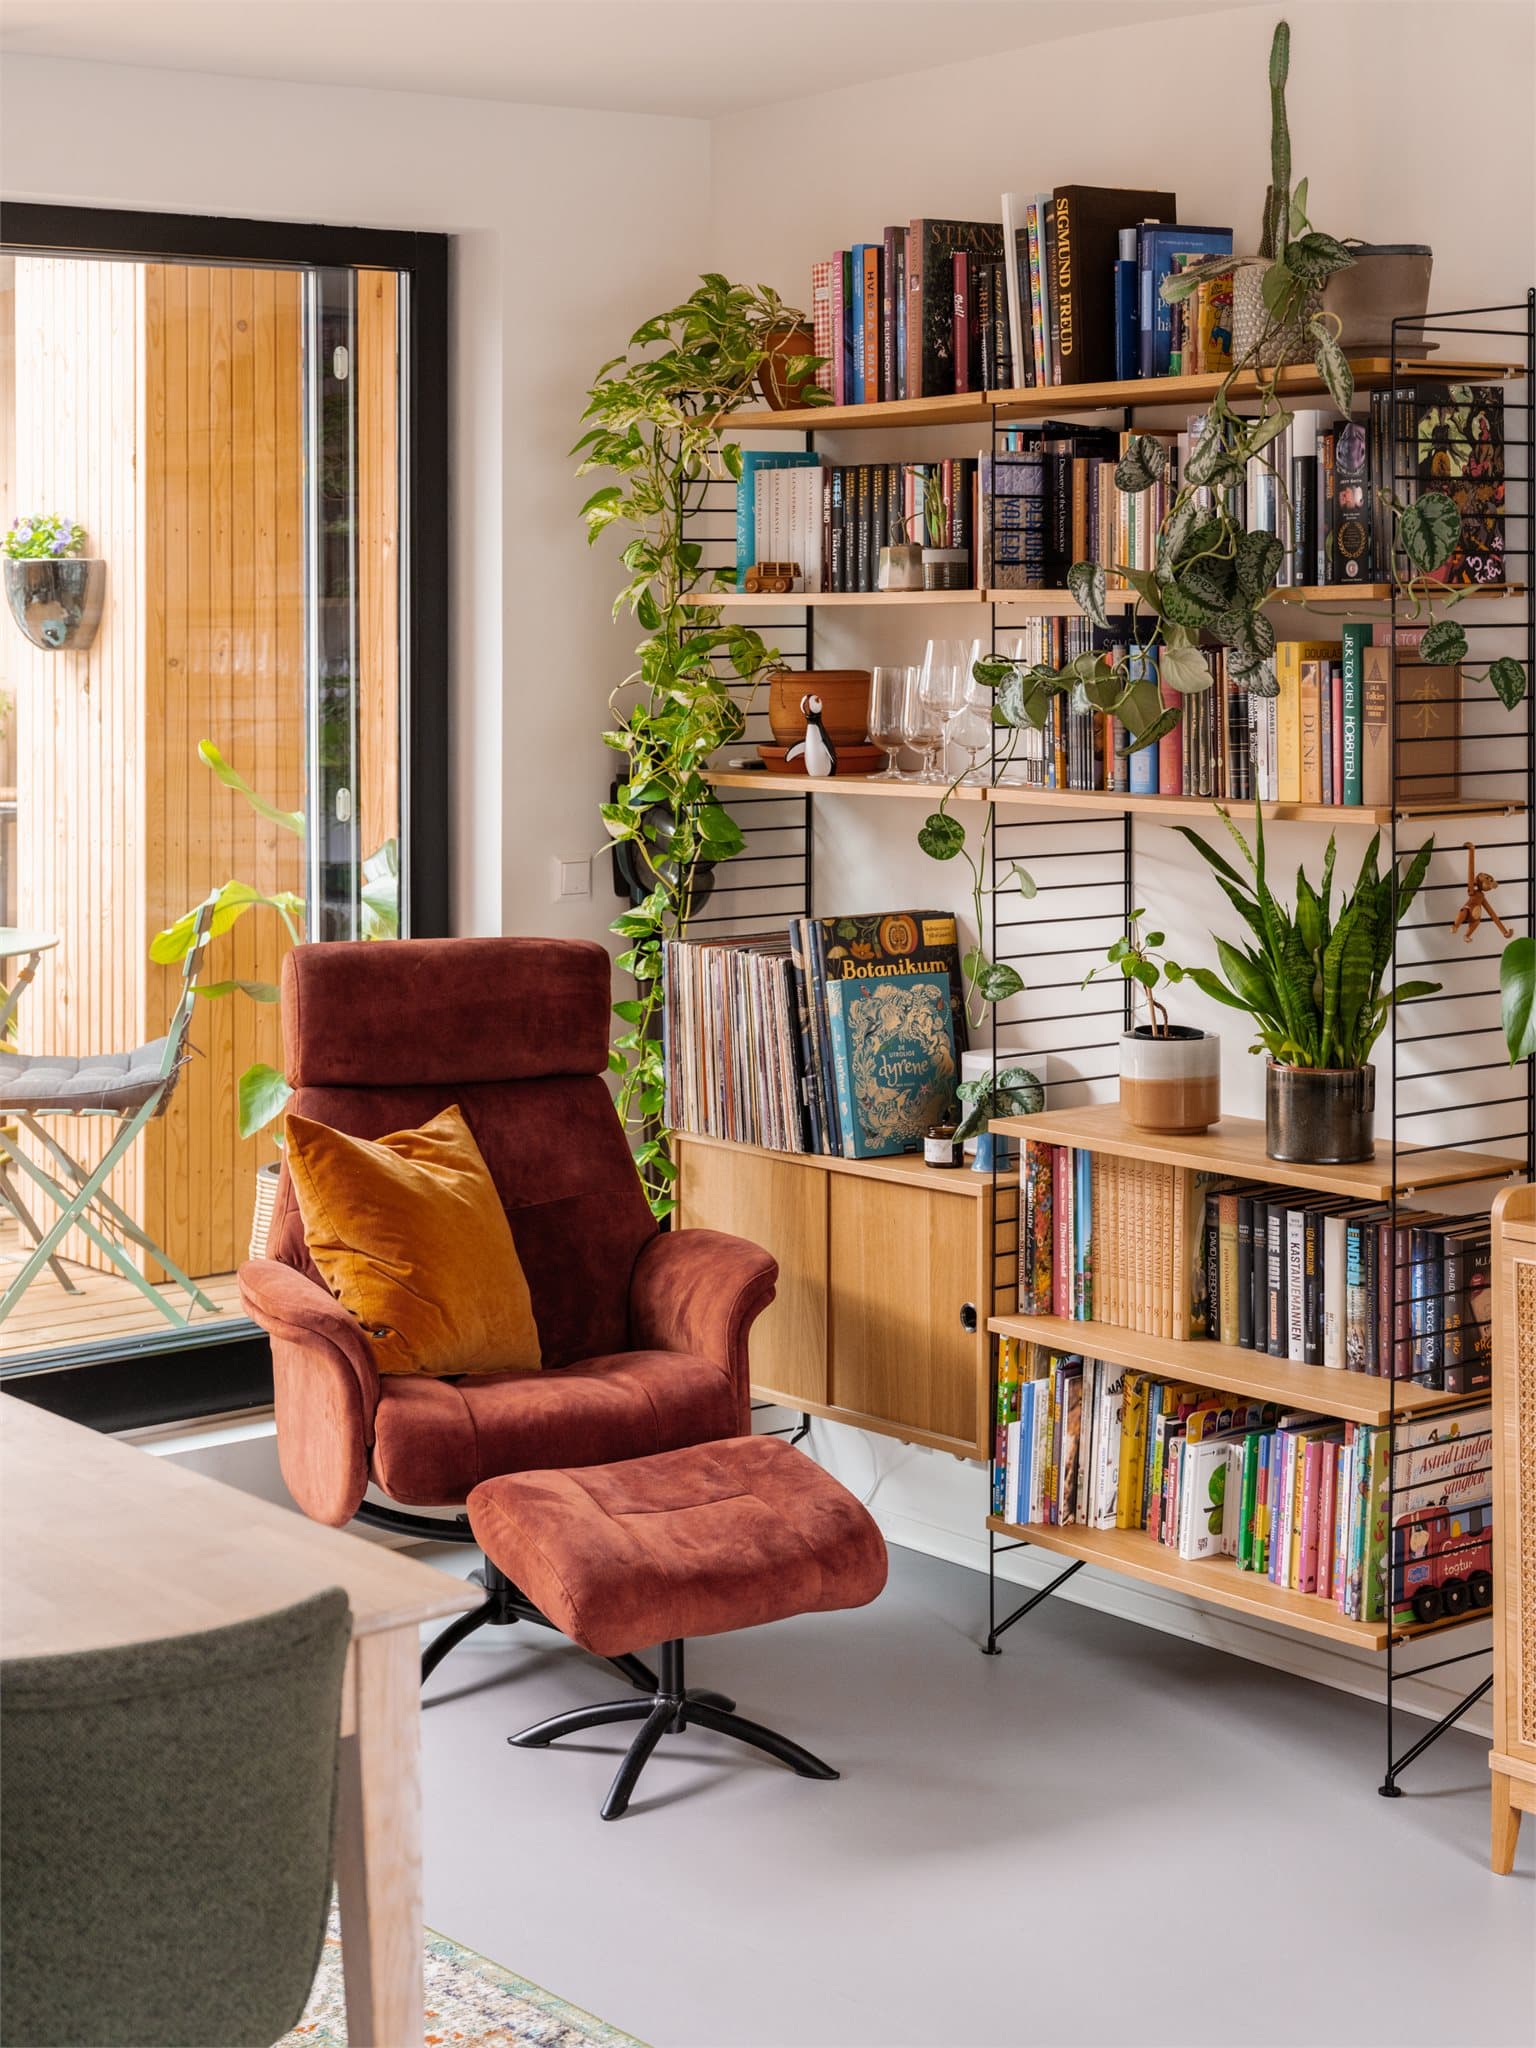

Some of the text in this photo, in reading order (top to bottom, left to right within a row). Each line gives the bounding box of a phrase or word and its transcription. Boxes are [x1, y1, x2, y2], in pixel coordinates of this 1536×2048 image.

[1056, 198, 1070, 287] SIGMUND
[833, 260, 841, 315] ISABELLAS
[867, 271, 876, 384] HVERDAGSMAT
[1060, 293, 1073, 356] FREUD
[1057, 458, 1066, 489] Discovery
[1058, 491, 1066, 499] of
[1058, 500, 1066, 510] the
[737, 489, 746, 557] WHY AXIS
[1058, 511, 1066, 553] Unconscious
[1344, 659, 1355, 709] TOLKIEN
[1303, 713, 1315, 773] DUNE
[1345, 715, 1356, 780] HOBBITEN
[841, 957, 948, 980] Botanikum
[878, 1055, 930, 1087] dyrene
[1163, 1175, 1171, 1202] MITT
[1174, 1177, 1182, 1206] MITT
[1268, 1215, 1280, 1254] ANNE
[1209, 1257, 1217, 1320] LAGERCRANTZ
[1268, 1255, 1280, 1290] HOLT
[1290, 1242, 1301, 1341] KASTANJEMANNEN
[1418, 1446, 1453, 1474] Astrid
[1443, 1558, 1473, 1577] togtur
